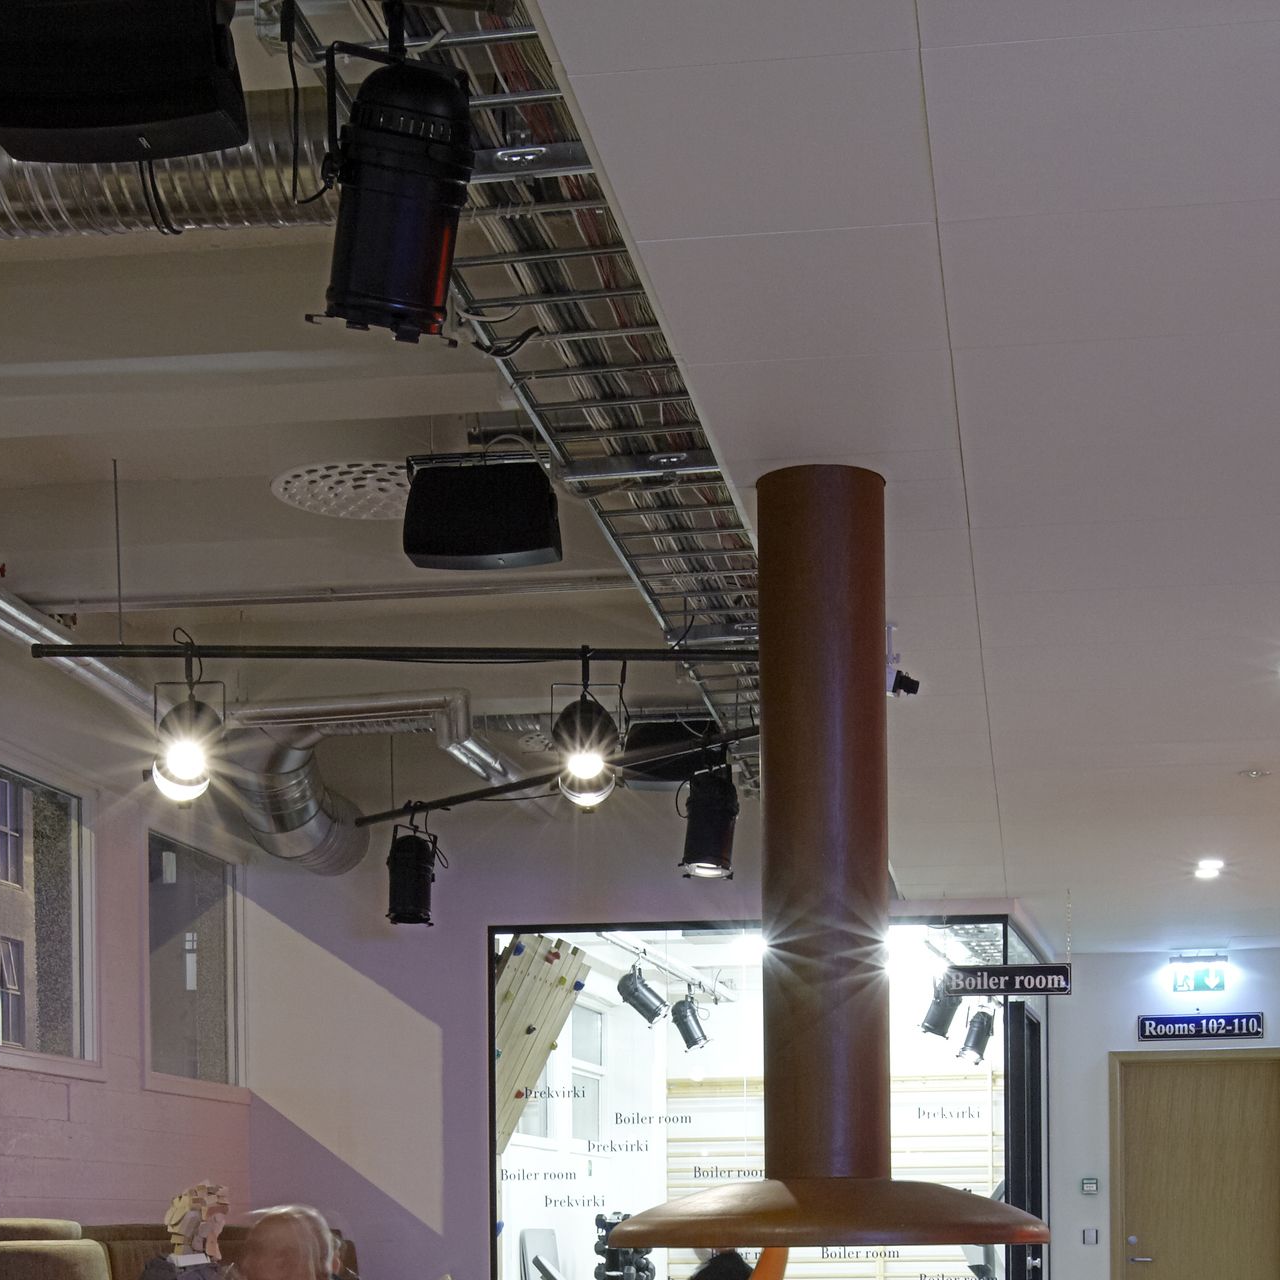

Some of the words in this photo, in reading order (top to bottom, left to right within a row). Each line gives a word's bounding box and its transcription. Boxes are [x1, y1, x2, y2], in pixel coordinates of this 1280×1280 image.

[950, 971, 1009, 990] Boiler
[1014, 974, 1066, 989] room
[1144, 1019, 1196, 1036] Rooms
[524, 1086, 586, 1099] Þrekvirki
[614, 1112, 655, 1125] Boiler
[658, 1114, 692, 1124] room
[500, 1168, 540, 1181] Boiler
[543, 1171, 577, 1180] room
[693, 1165, 734, 1178] Boiler
[821, 1246, 862, 1259] Boiler
[865, 1249, 900, 1259] room
